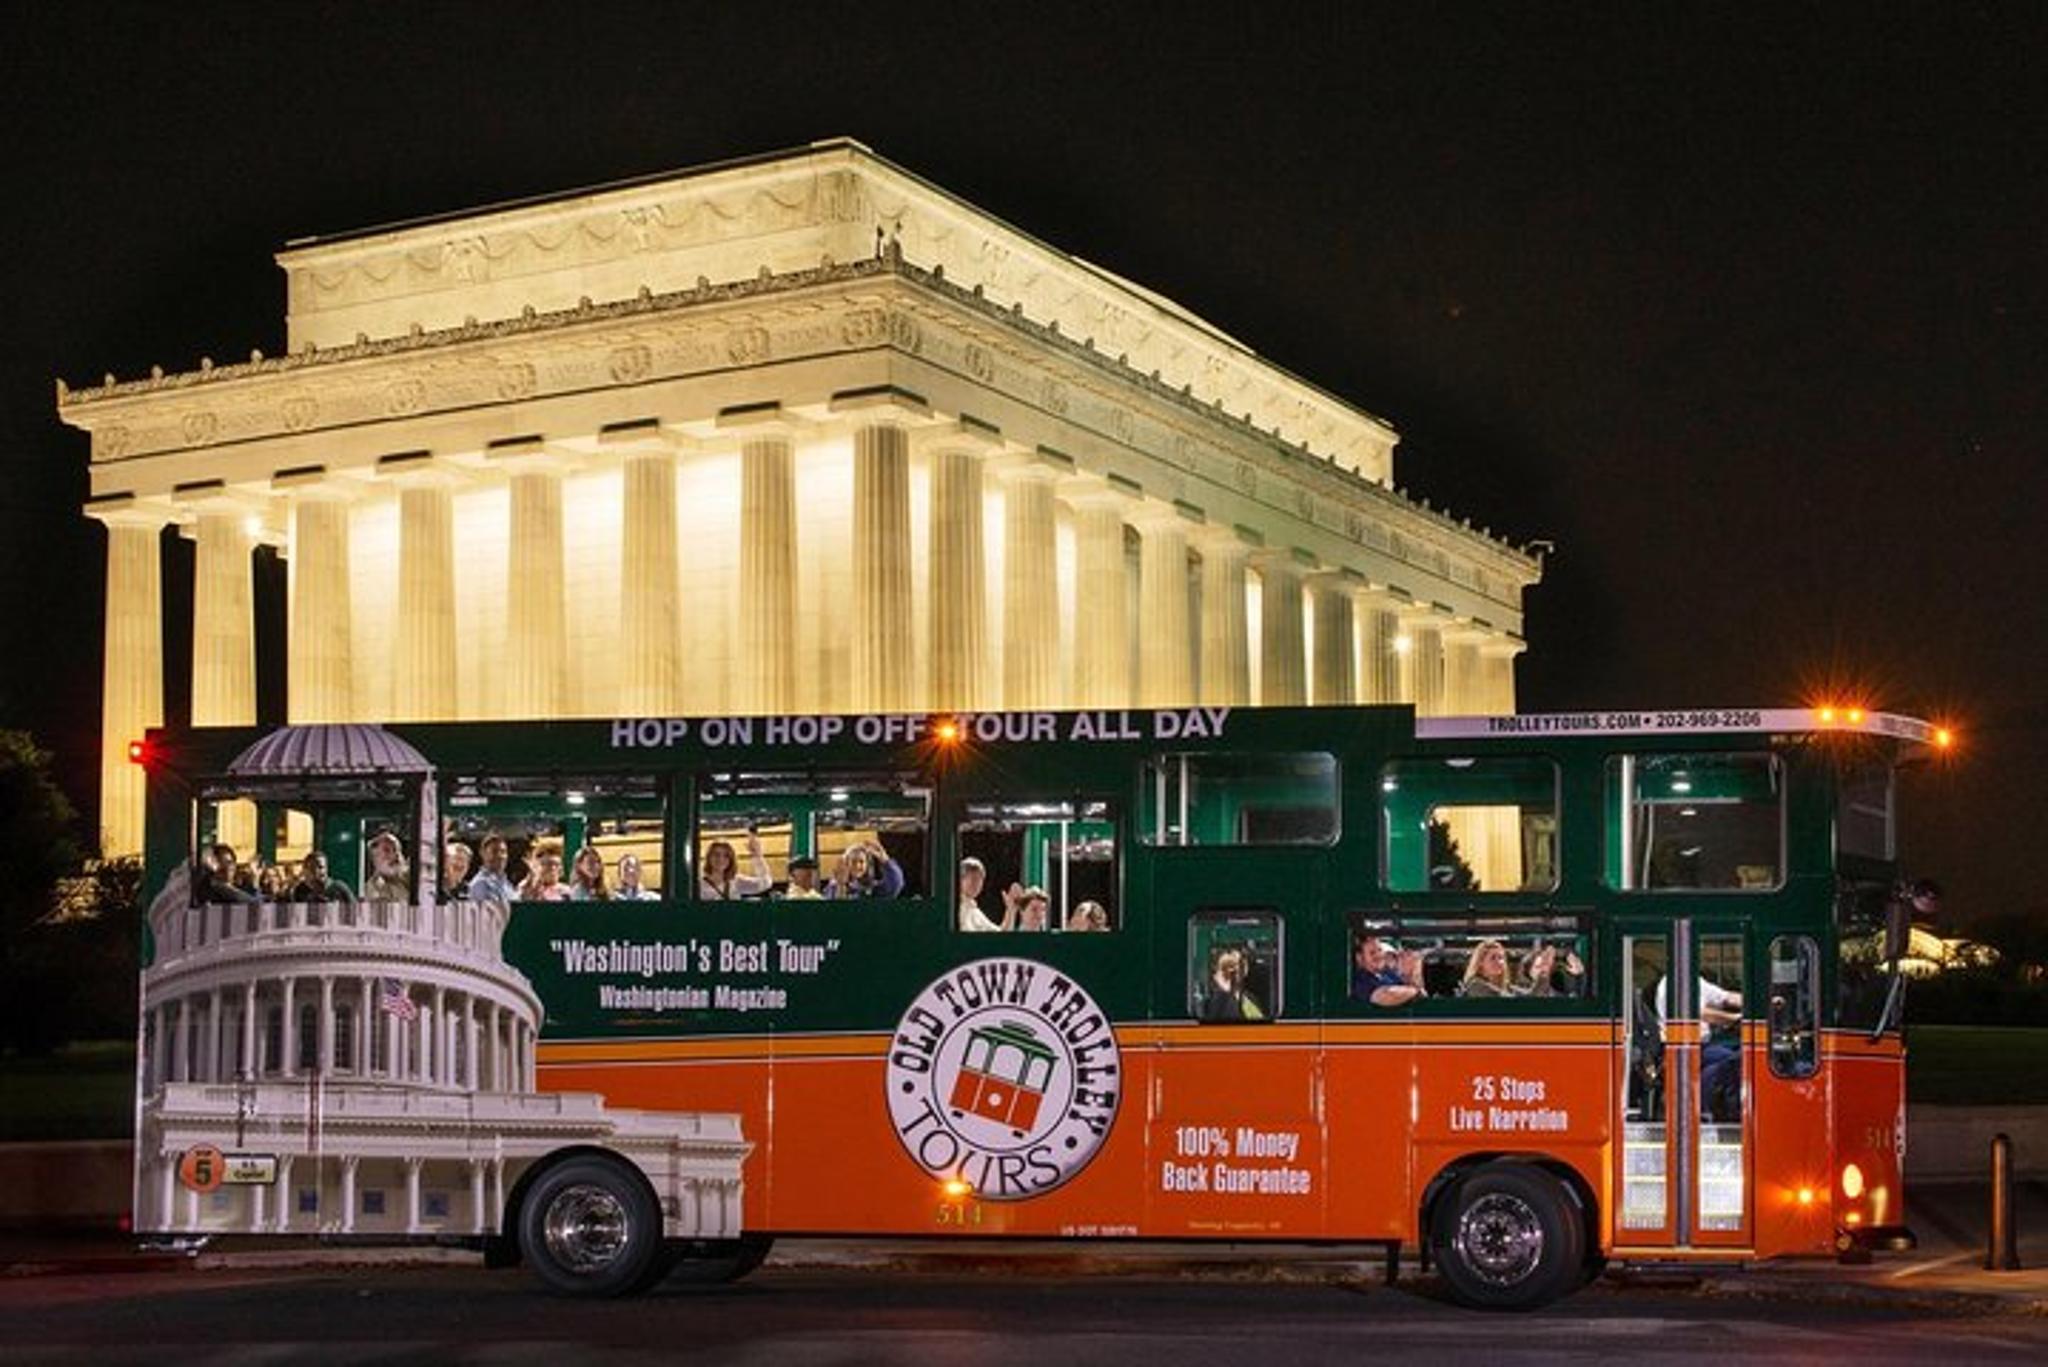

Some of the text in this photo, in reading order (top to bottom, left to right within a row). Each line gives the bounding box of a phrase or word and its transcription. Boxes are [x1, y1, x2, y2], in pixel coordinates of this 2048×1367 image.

[611, 706, 1231, 747] HOP ON HOP OFF TOUR ALL DAY
[1489, 714, 1641, 732] TROLLEYTOURS.COM
[550, 939, 711, 977] "Washington's
[719, 939, 768, 973] Best
[600, 985, 787, 1012] Washingtonian Magazine
[891, 962, 1118, 1136] OLD TOWN TROLLEY
[1472, 1076, 1546, 1104] 25 Stops
[1450, 1106, 1568, 1131] Live Narration
[901, 1096, 1061, 1195] TOURS
[1176, 1127, 1300, 1162] 100% Money
[194, 1159, 212, 1184] 5
[1162, 1161, 1311, 1194] Back Guarantee
